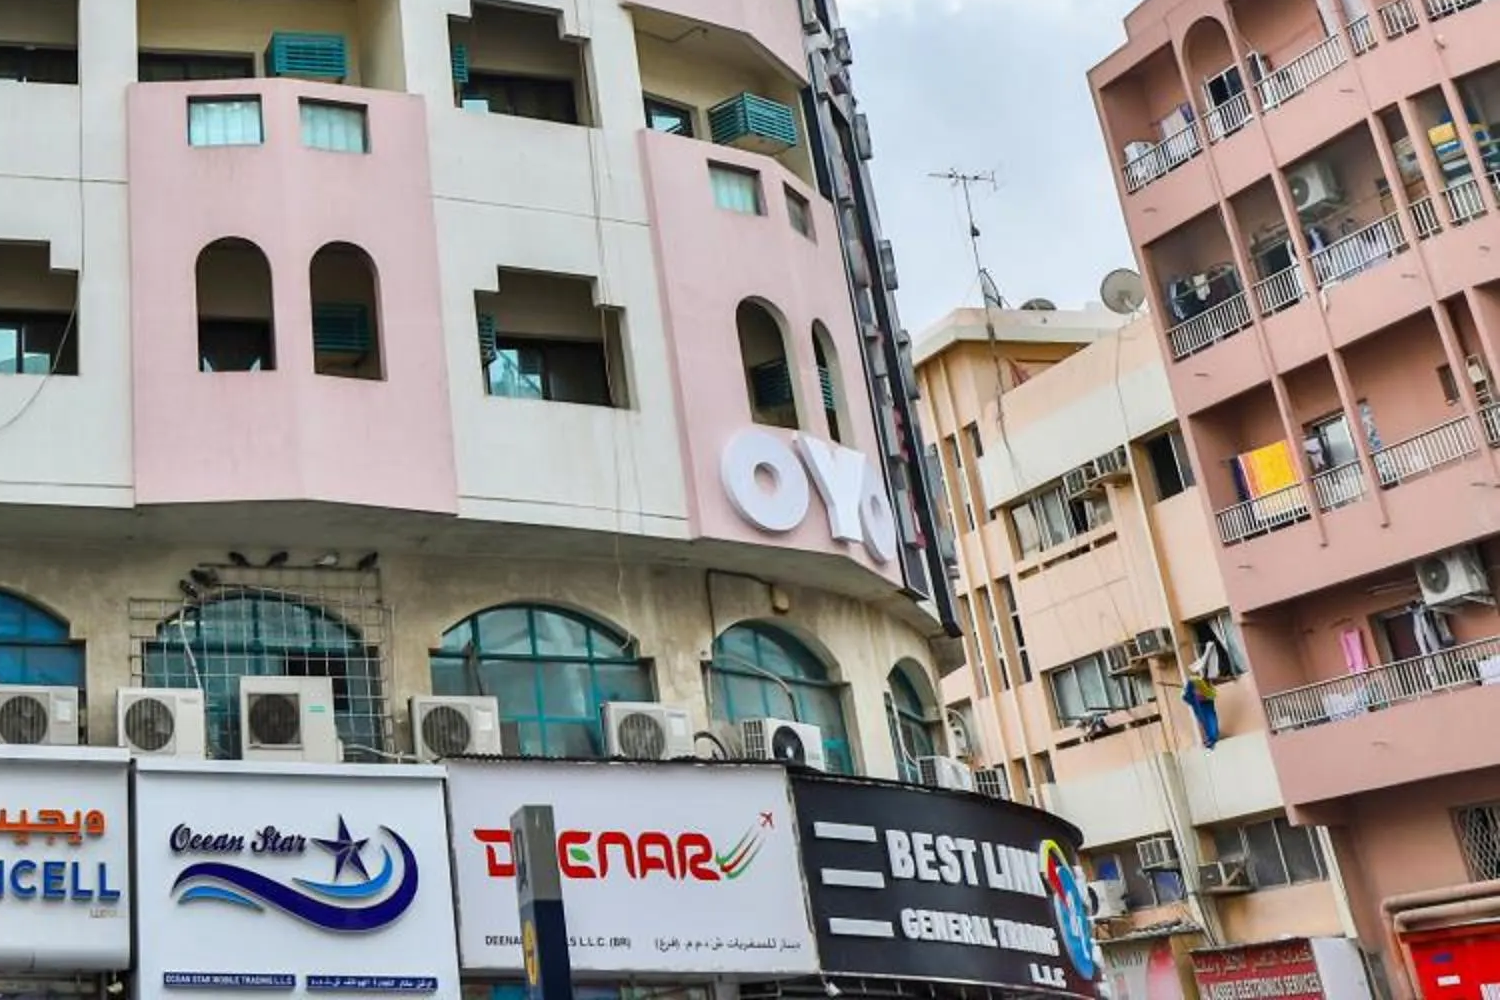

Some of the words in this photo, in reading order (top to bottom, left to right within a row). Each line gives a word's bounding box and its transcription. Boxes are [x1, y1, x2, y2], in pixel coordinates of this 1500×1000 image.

[720, 426, 896, 565] OYO
[169, 823, 245, 853] Ocean
[251, 825, 307, 853] Star
[473, 829, 721, 881] DENAR
[885, 829, 979, 886] BEST
[901, 908, 998, 947] GENERAL
